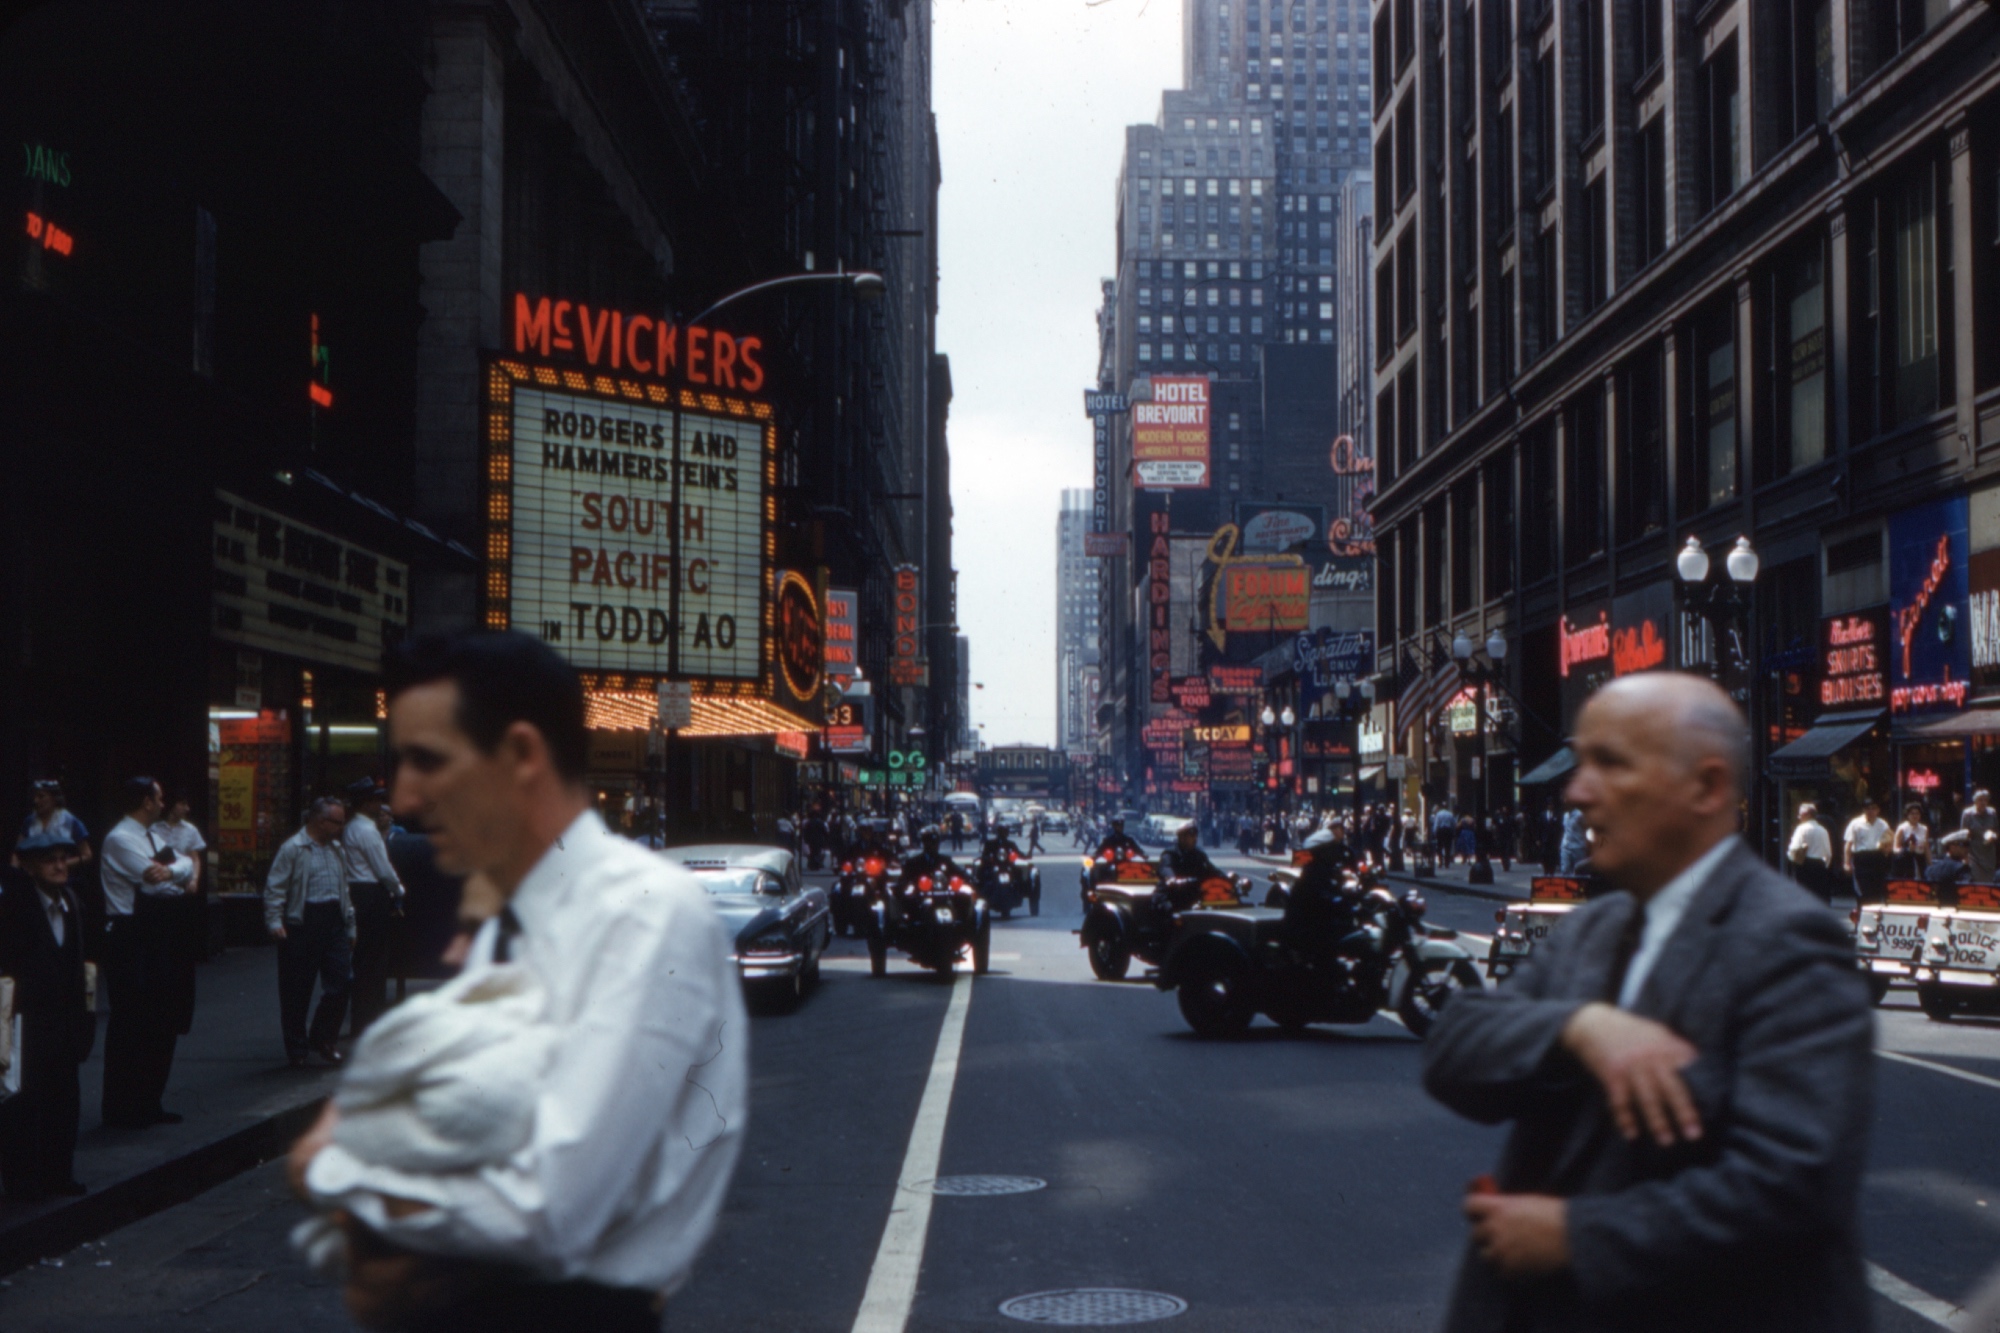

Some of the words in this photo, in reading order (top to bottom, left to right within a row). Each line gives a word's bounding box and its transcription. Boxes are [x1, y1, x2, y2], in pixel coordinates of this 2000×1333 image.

[1155, 383, 1207, 402] HOTEL
[1087, 395, 1126, 410] HOTEL
[1137, 404, 1206, 424] BREVOORT
[543, 408, 665, 450] RODGERS
[691, 430, 738, 461] AND
[1137, 430, 1174, 443] MODERN
[1176, 430, 1207, 443] ROOMS
[1095, 413, 1107, 531] BREVOORT
[1233, 571, 1305, 598] FORUM
[826, 600, 848, 618] IRST
[897, 570, 917, 657] BOND
[543, 619, 562, 641] IN
[825, 623, 853, 641] DERAL
[1329, 660, 1358, 670] ONLY
[1822, 673, 1882, 705] BLOUSES
[1193, 728, 1238, 741] TODAY
[1876, 924, 1921, 937] POLIC
